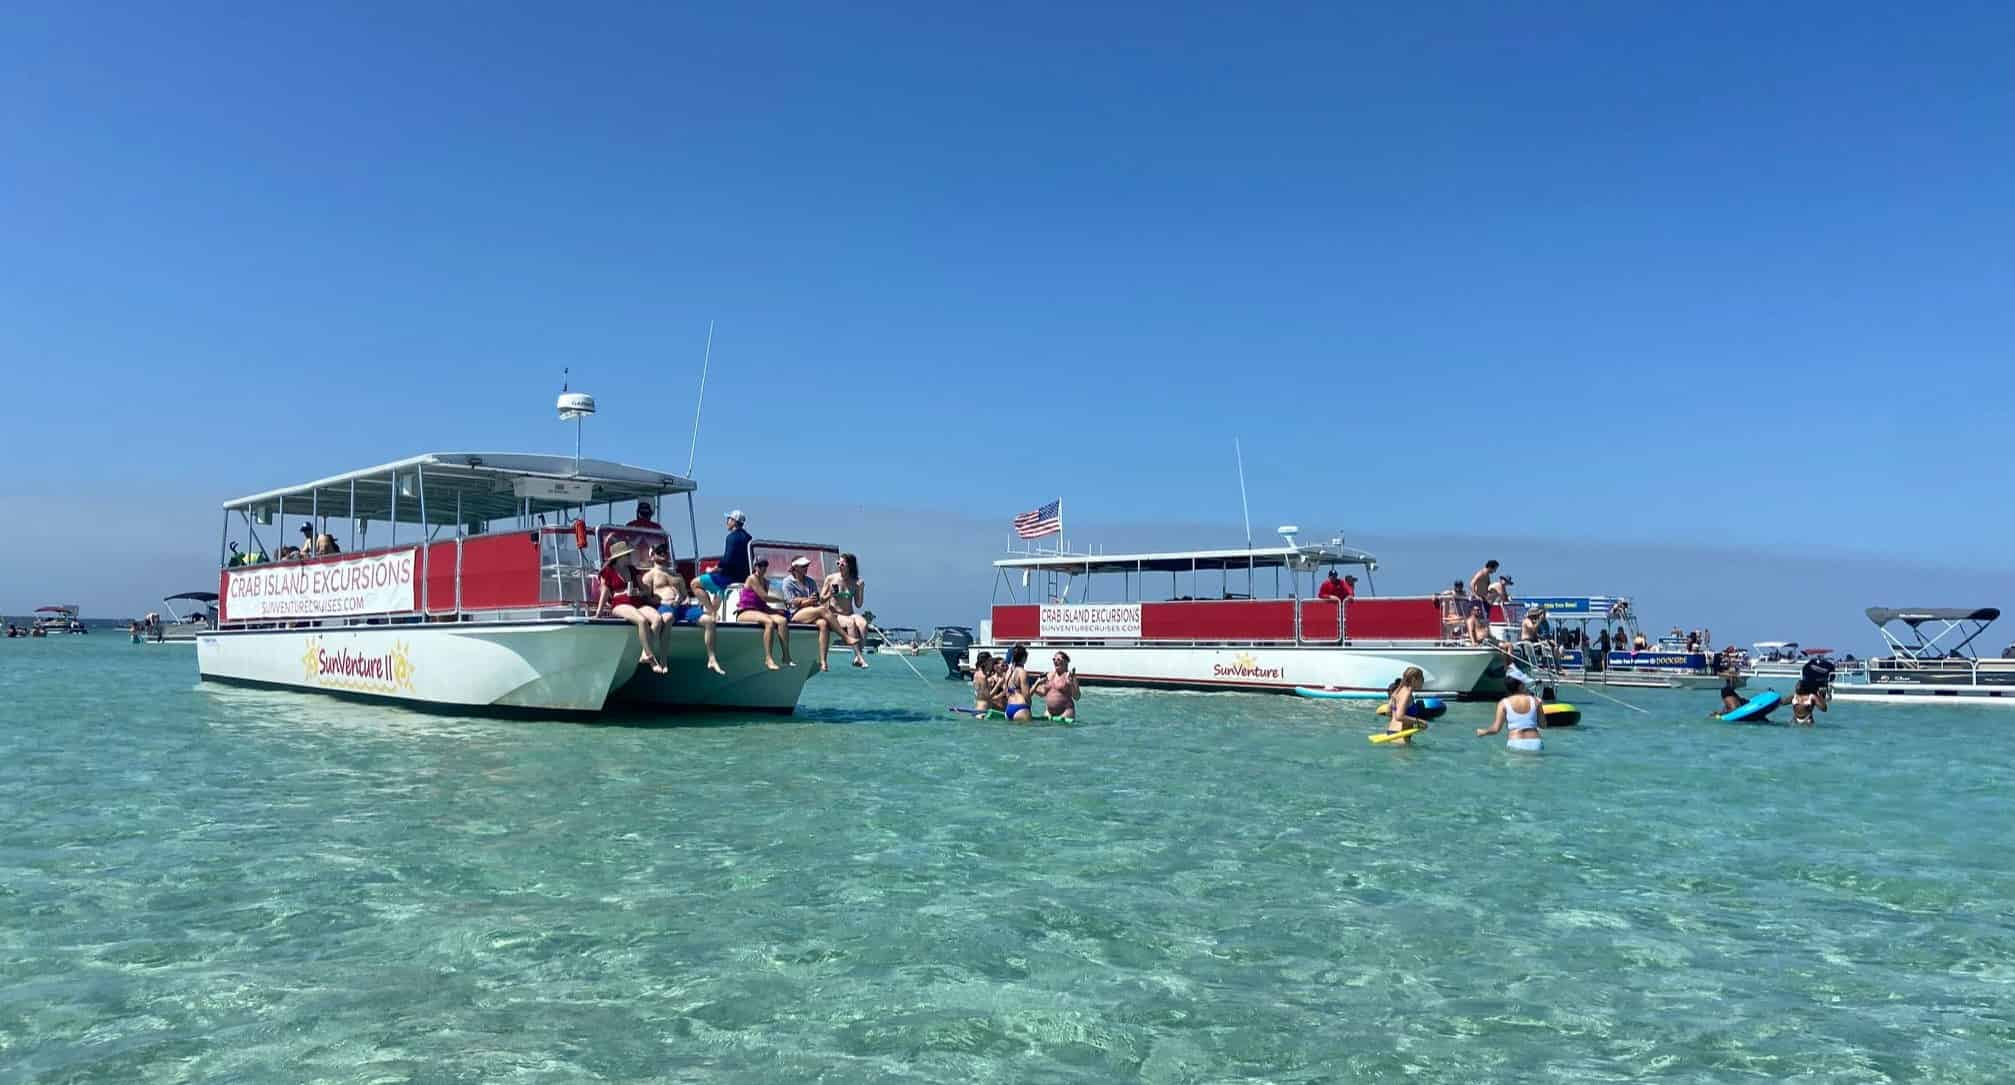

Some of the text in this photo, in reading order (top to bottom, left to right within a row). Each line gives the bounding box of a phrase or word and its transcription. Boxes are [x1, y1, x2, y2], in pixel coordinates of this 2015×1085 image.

[231, 558, 411, 598] CRAB ISLAND EXCURSIONS
[261, 596, 365, 615] SUNVENTURECRUISES.COM
[1042, 608, 1140, 623] CRAB ISLAND EXCURSIONS
[1041, 624, 1140, 632] SUNVENTURECRUISES.COM
[318, 647, 393, 682] SunVenture II
[1214, 663, 1280, 678] SunVenture
